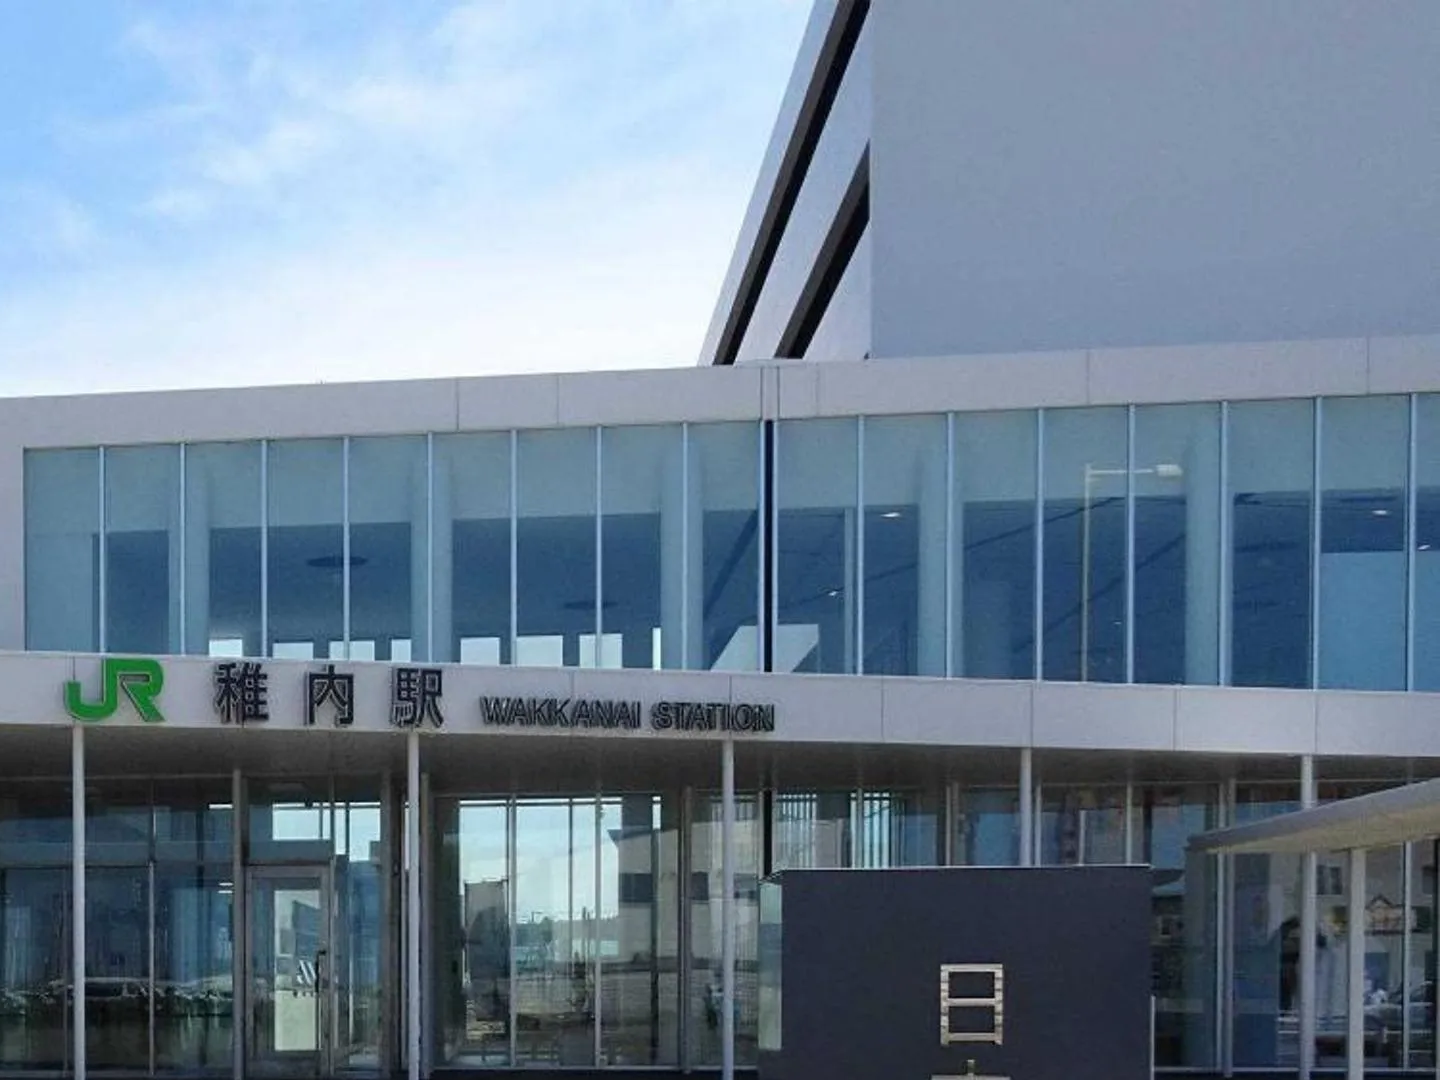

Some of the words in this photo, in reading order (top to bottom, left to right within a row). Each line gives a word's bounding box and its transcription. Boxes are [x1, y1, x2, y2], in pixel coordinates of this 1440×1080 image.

[66, 658, 165, 722] JR
[213, 662, 444, 728] 稚内駅
[481, 696, 641, 729] WAKKANAI
[651, 701, 775, 732] STATION
